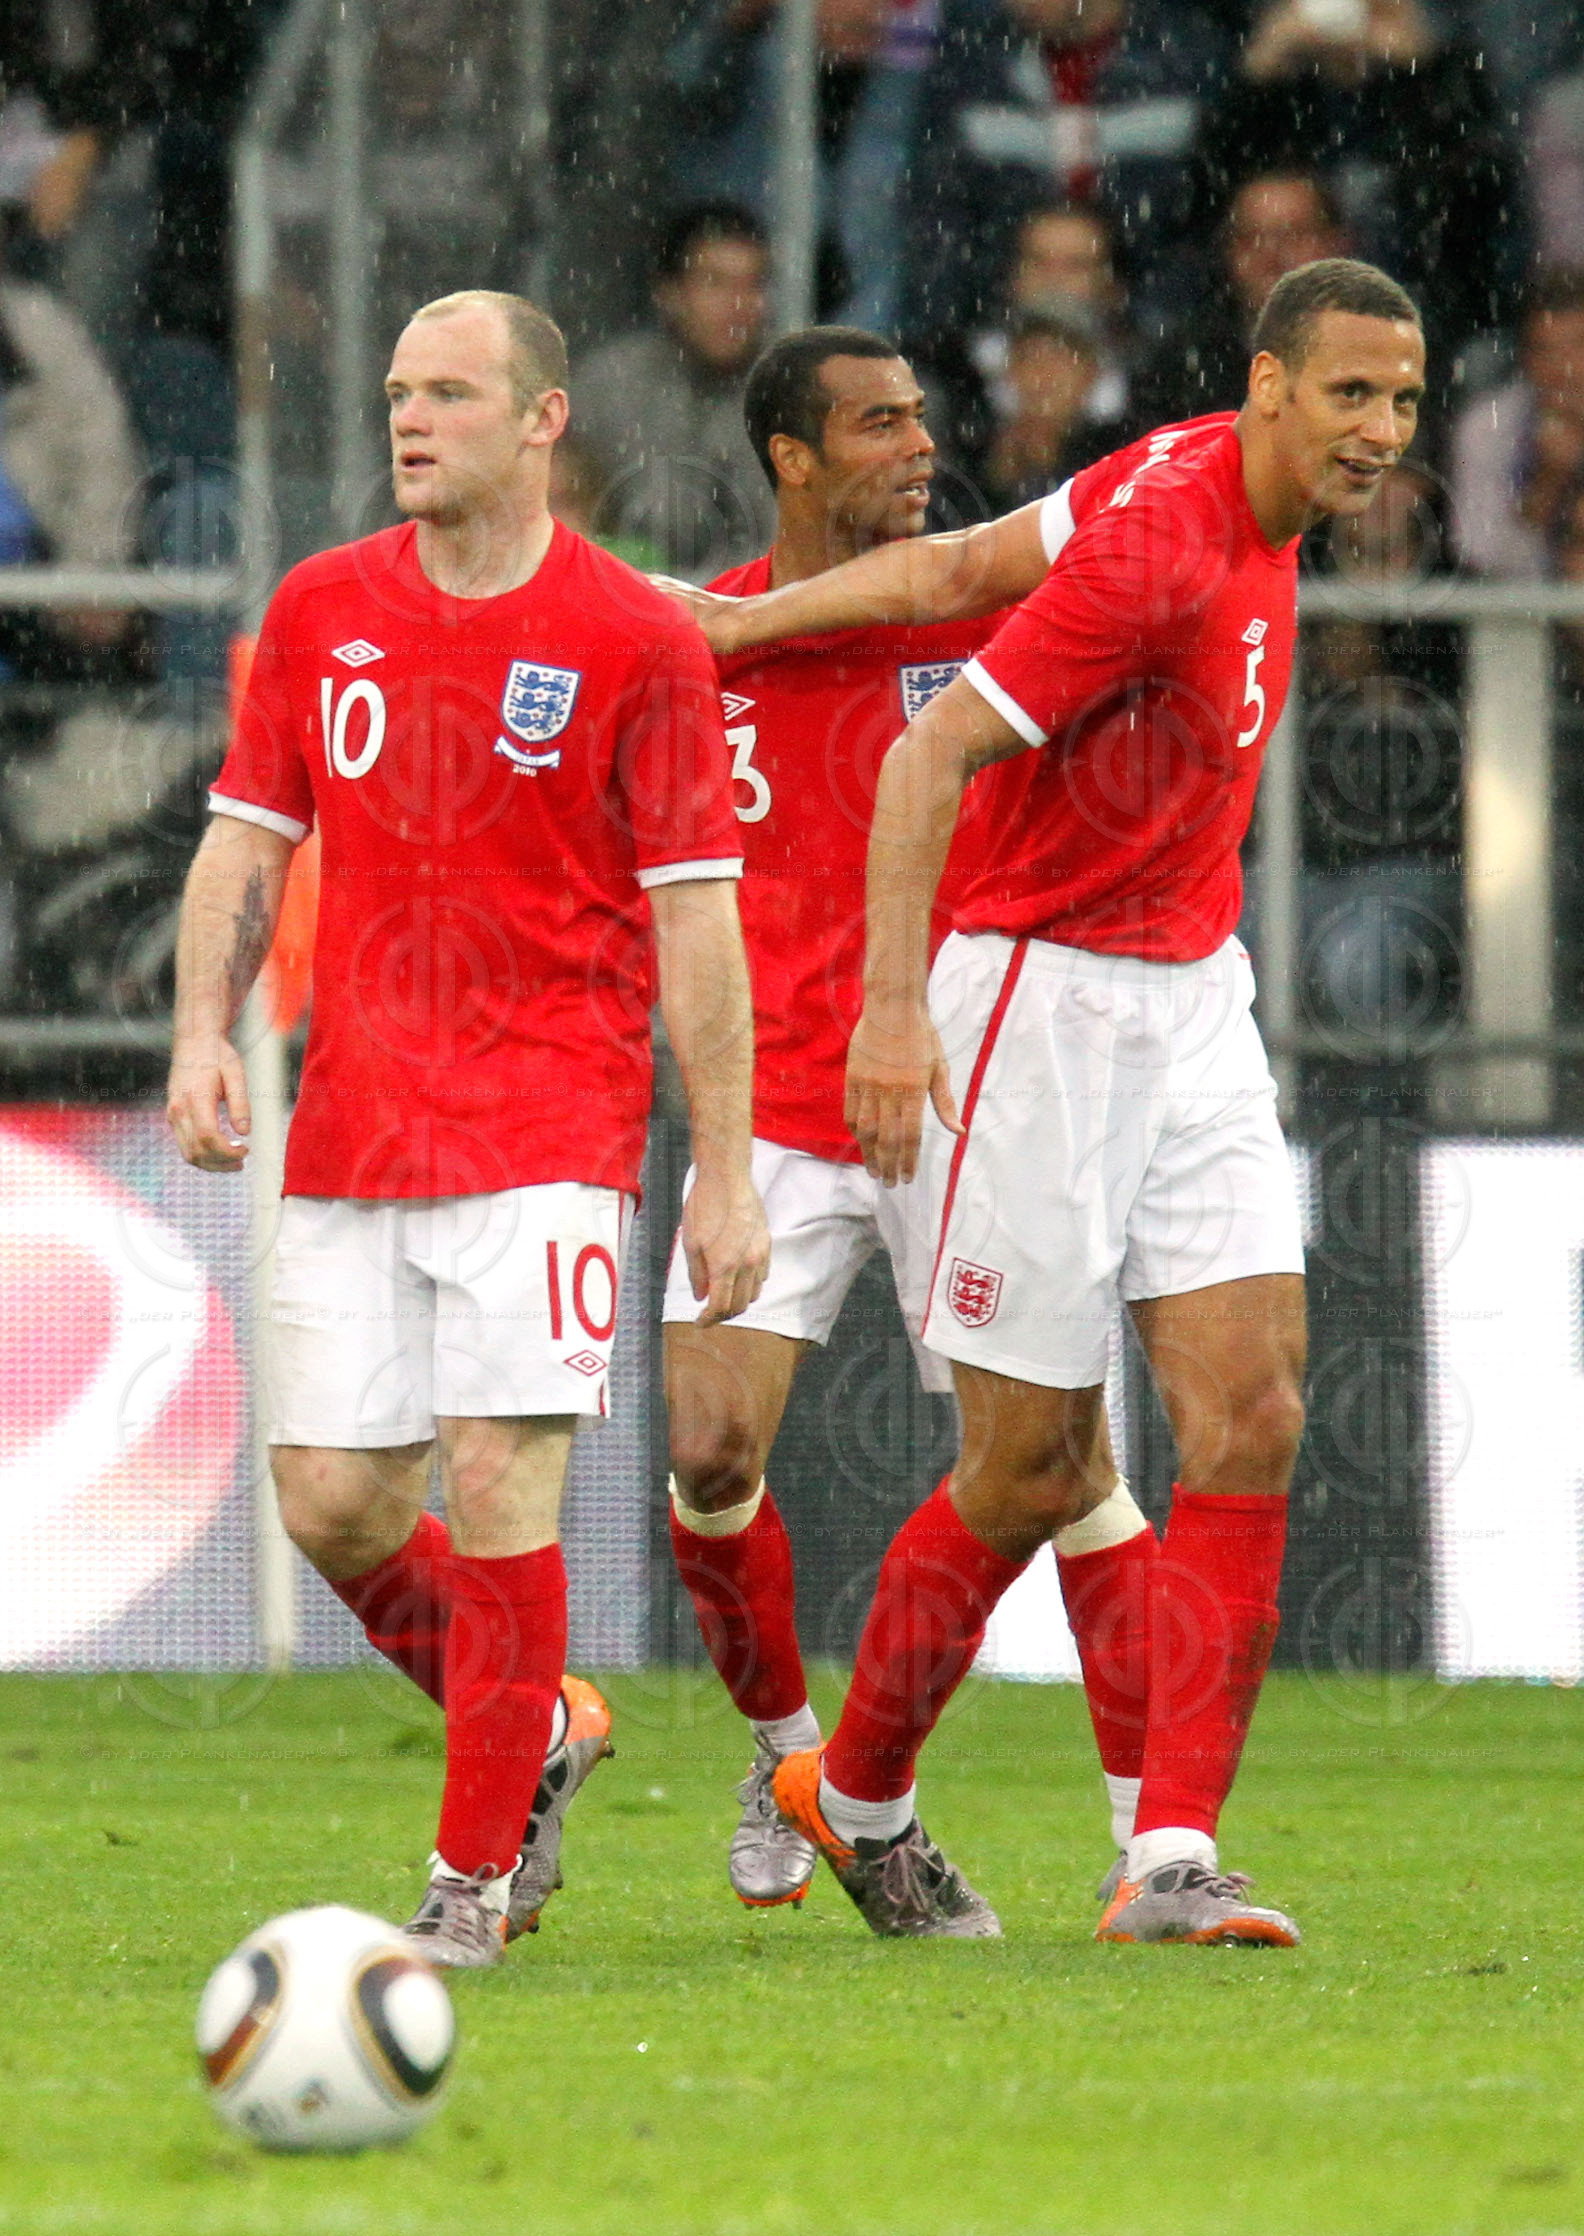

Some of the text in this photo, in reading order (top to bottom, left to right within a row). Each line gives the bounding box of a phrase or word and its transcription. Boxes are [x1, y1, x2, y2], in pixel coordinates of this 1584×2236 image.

[321, 677, 387, 780] 10
[1237, 645, 1265, 748] 5
[512, 765, 537, 778] 2010
[724, 724, 772, 823] 3
[546, 1240, 616, 1342] 10
